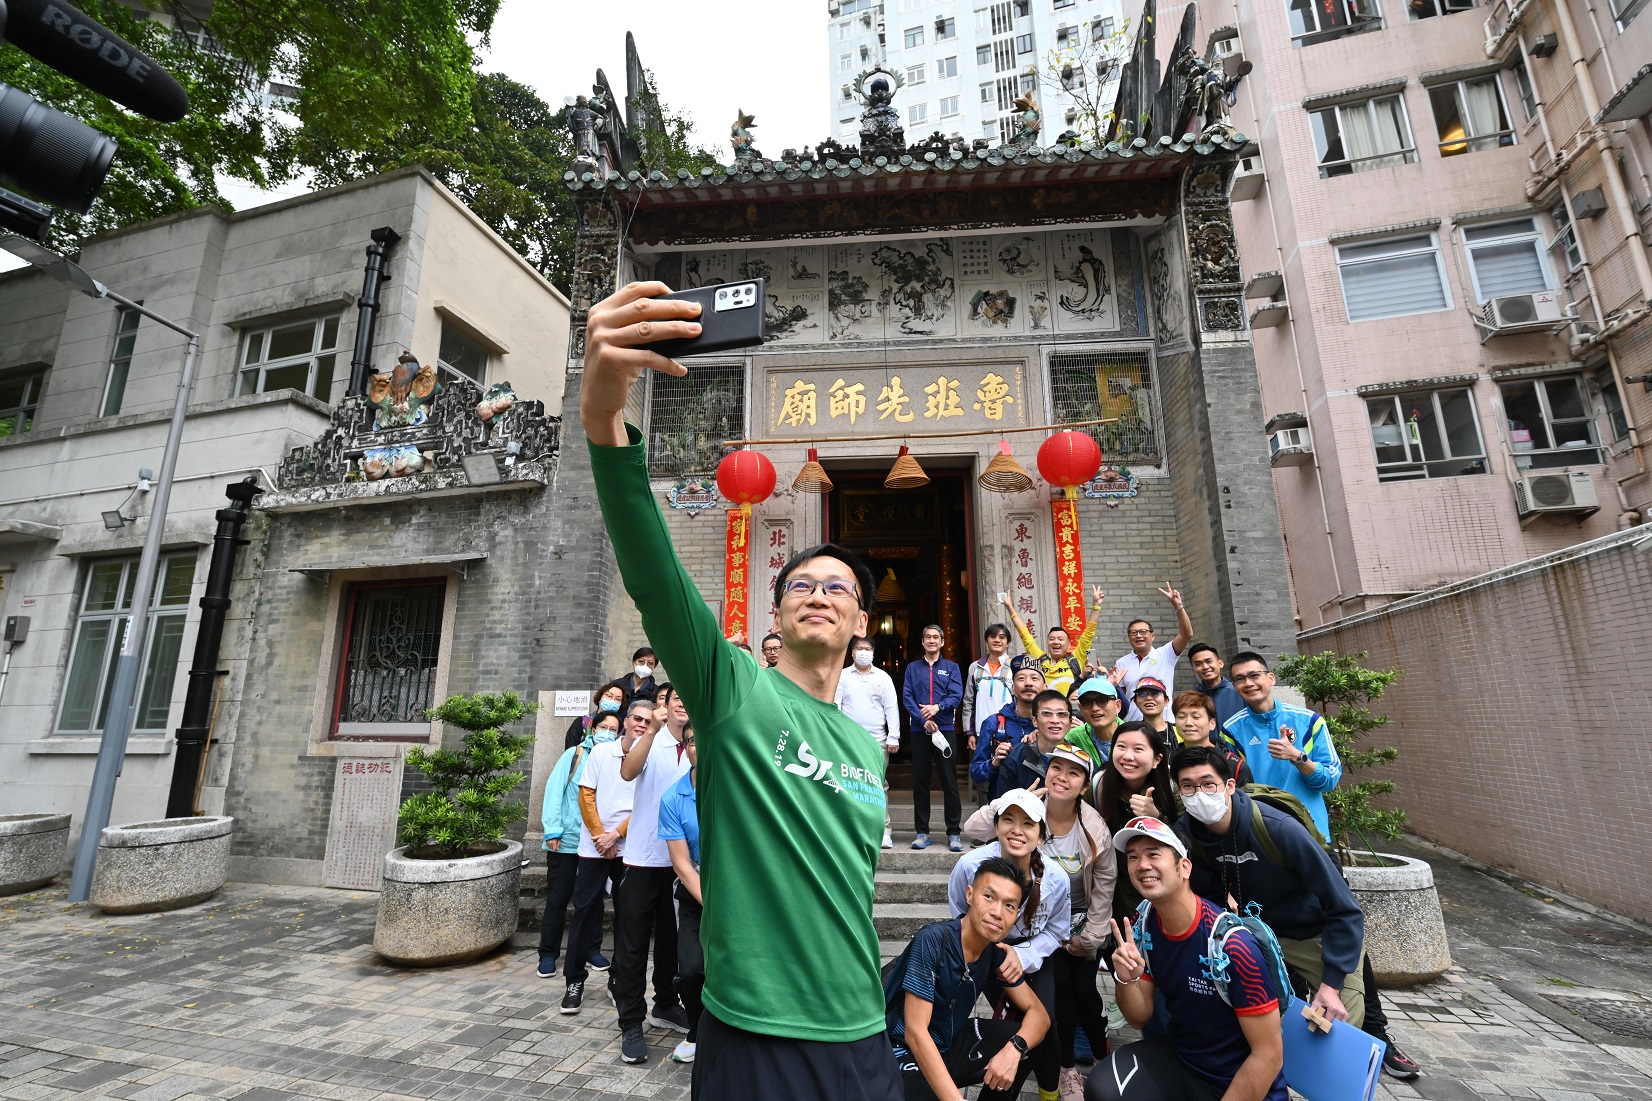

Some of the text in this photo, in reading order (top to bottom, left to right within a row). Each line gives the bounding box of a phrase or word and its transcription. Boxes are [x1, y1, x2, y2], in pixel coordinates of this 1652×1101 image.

[41, 4, 151, 83] RØDE
[728, 518, 747, 635] 家和事順隨人意
[1058, 510, 1083, 631] 富貴吉祥永平安
[557, 695, 588, 703] 小心地滑
[774, 729, 790, 767] 7.28.19
[842, 780, 858, 790] SAN
